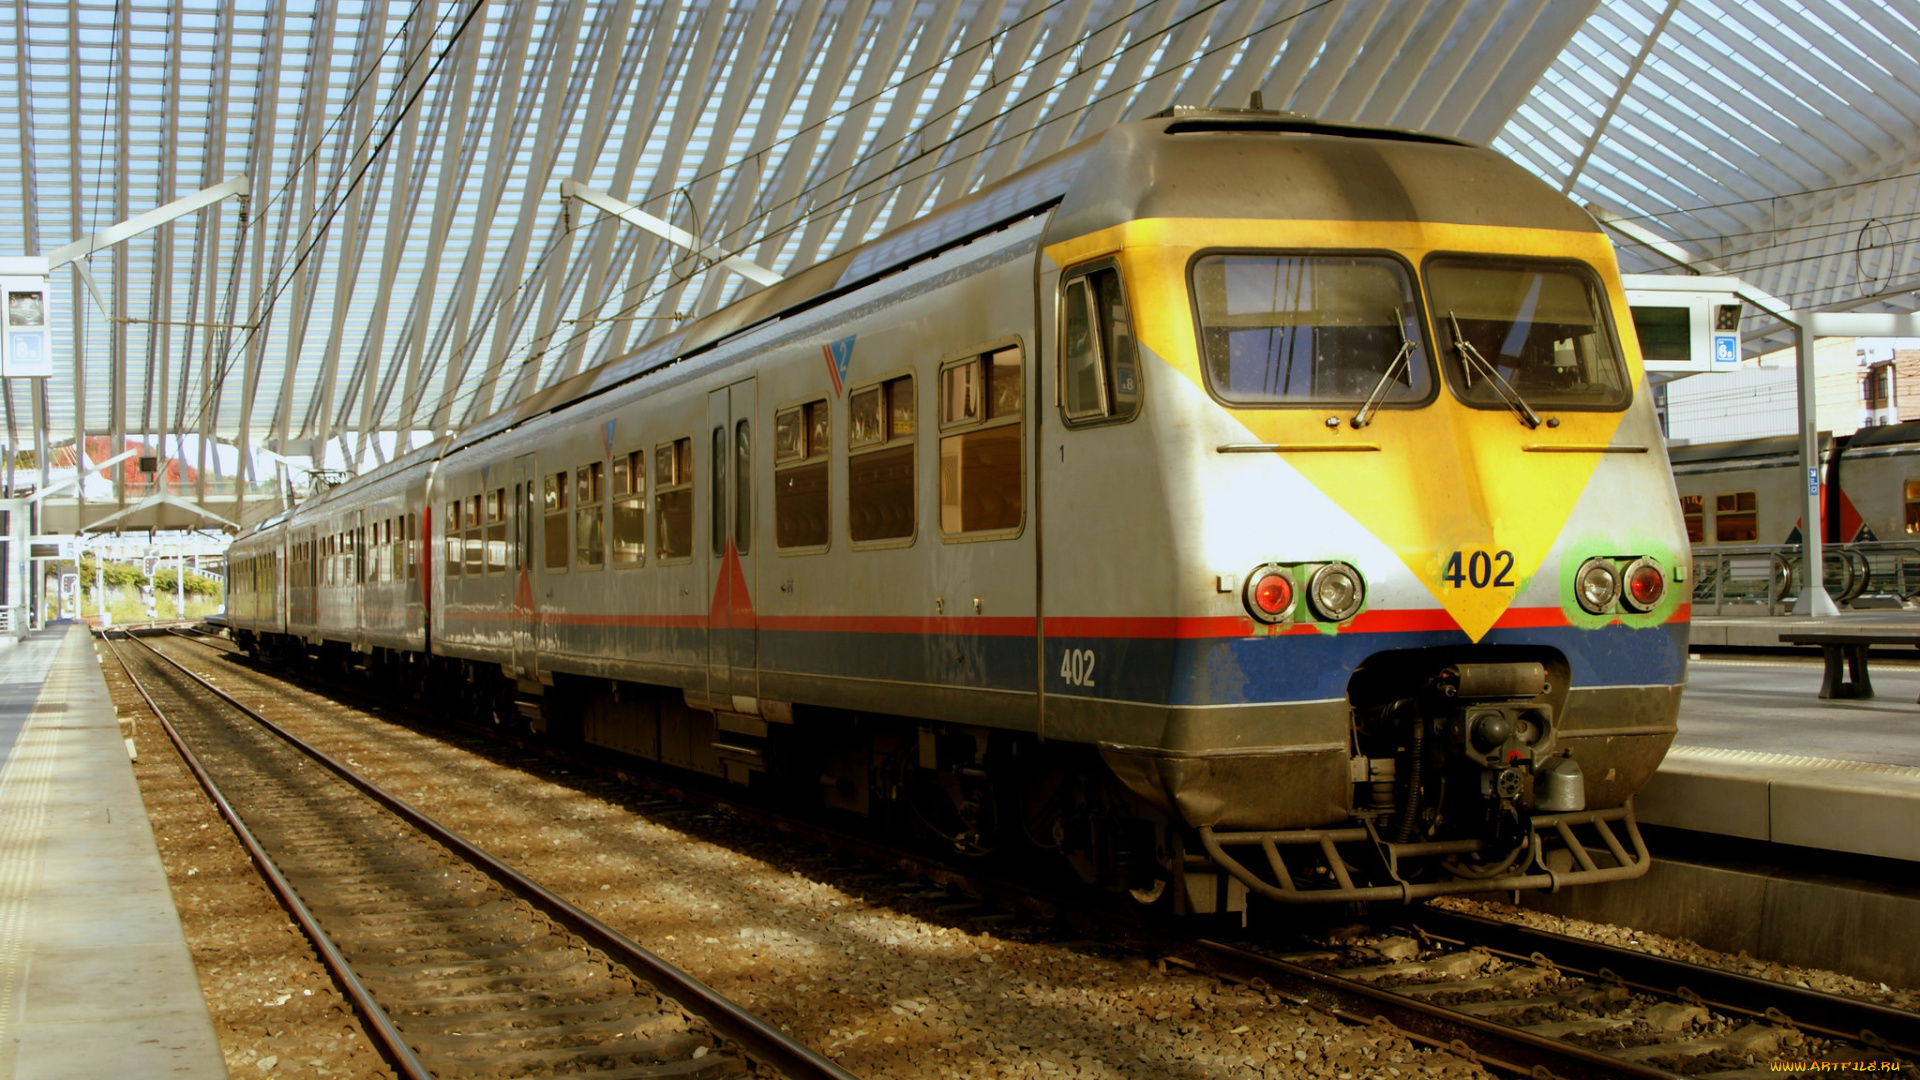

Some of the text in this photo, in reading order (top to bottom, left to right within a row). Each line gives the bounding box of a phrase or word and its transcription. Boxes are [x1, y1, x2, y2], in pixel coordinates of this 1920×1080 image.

[840, 342, 847, 372] 2
[1444, 550, 1514, 588] 402
[1060, 648, 1095, 687] 402
